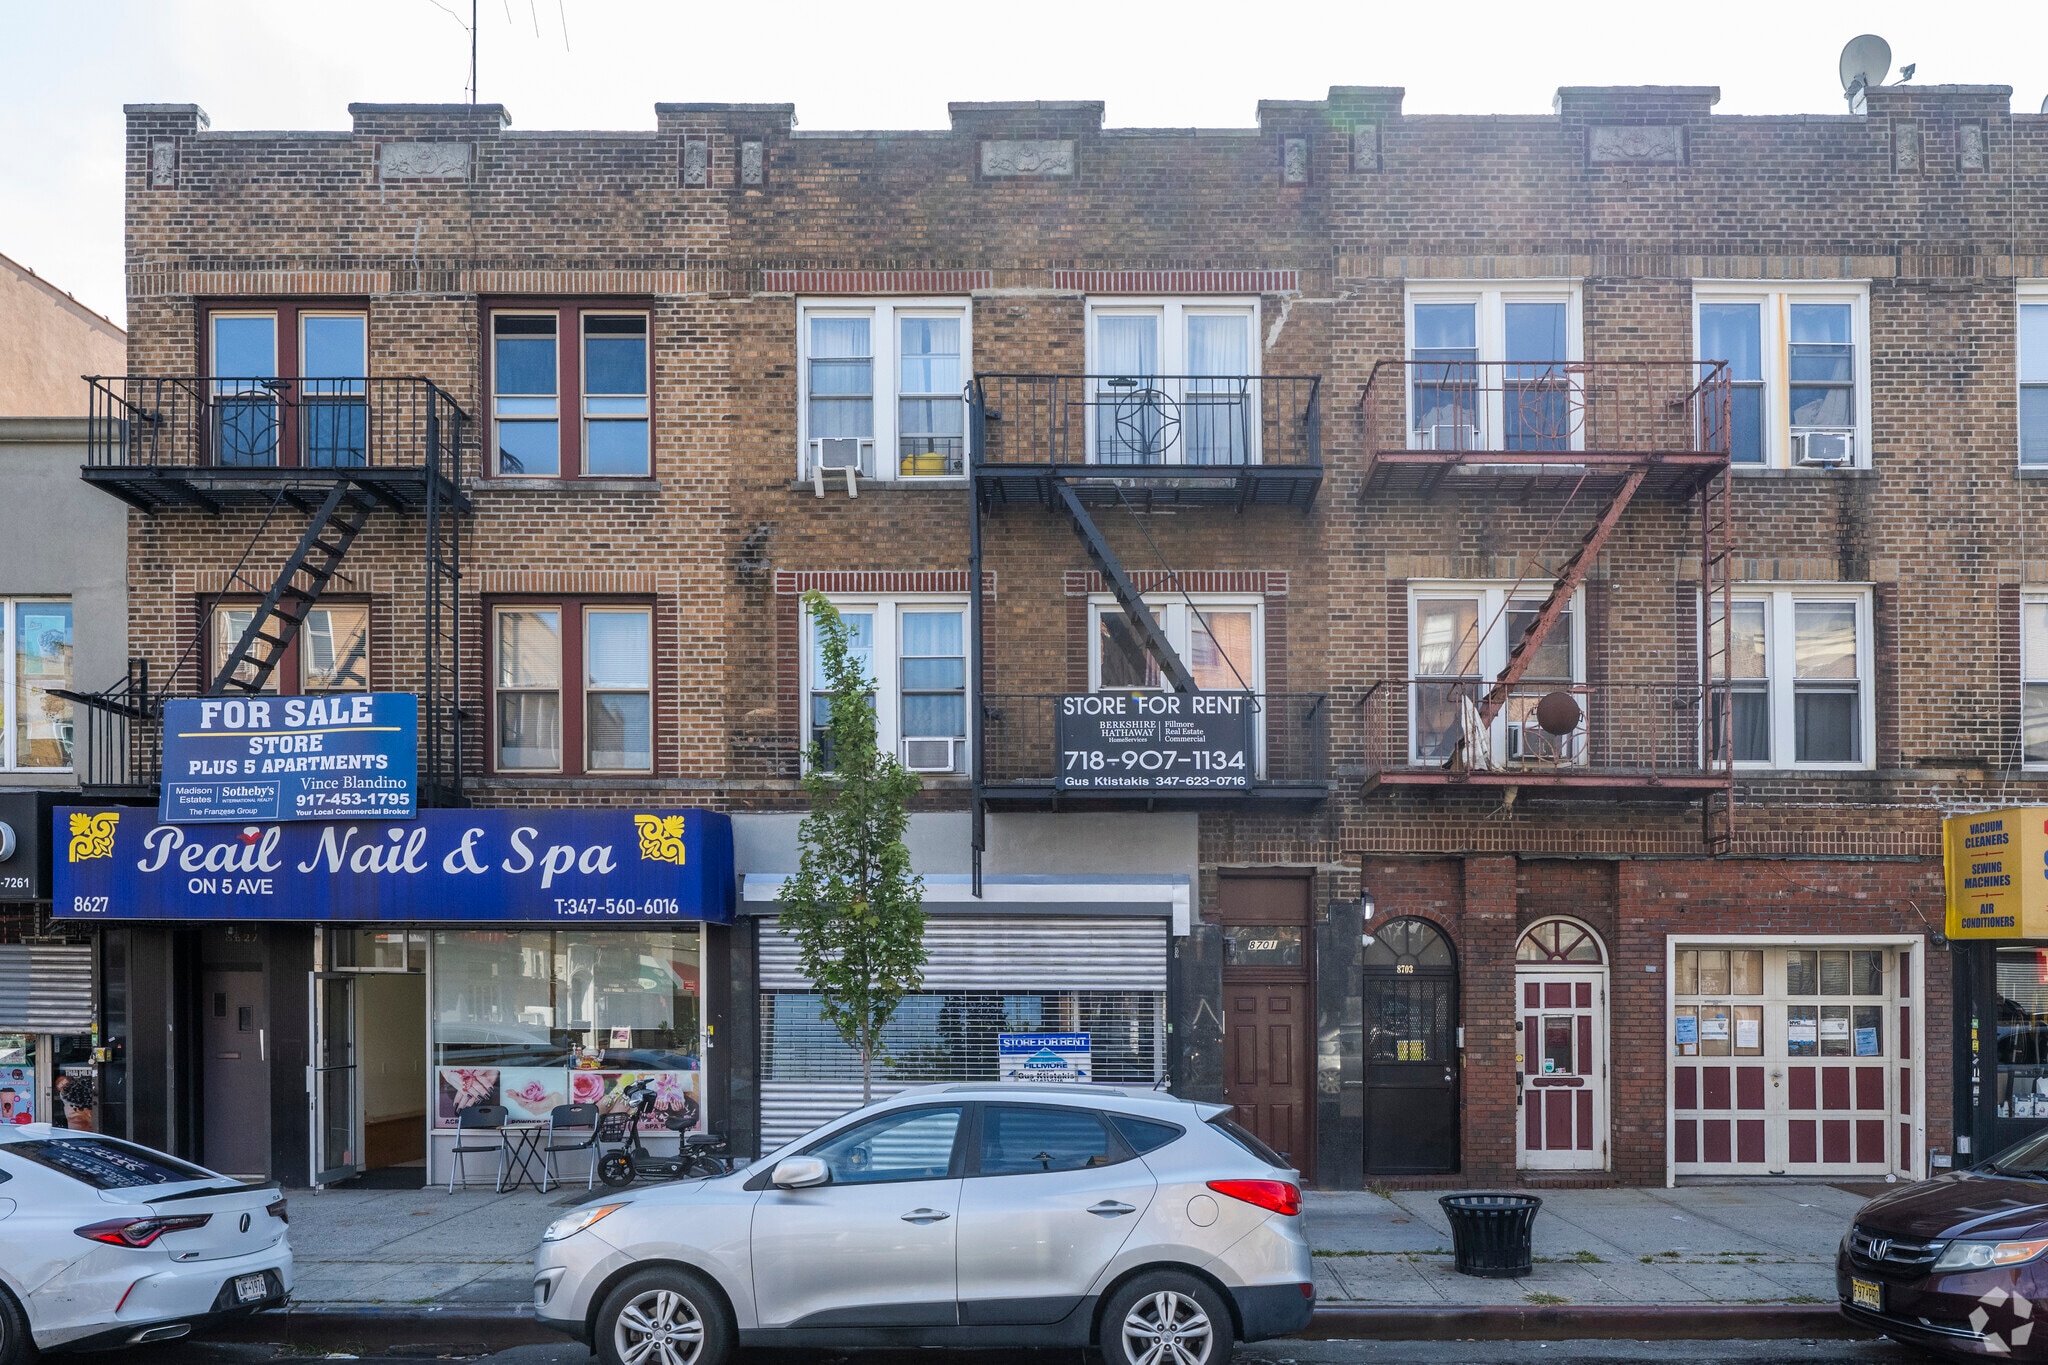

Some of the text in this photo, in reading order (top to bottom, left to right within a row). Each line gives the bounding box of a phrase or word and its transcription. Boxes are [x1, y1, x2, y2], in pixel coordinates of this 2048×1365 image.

[1063, 696, 1242, 715] STORE FOR RENT
[200, 696, 373, 729] FOR SALE
[1100, 720, 1156, 729] BERKSHIRE
[1164, 720, 1194, 728] Fillmore
[1101, 729, 1155, 737] HATHAWAY
[1164, 735, 1206, 743] Commercial
[249, 734, 323, 755] STORE
[188, 754, 388, 775] PLUS 5 APARTMENTS
[1064, 750, 1246, 770] 718-907-1134
[300, 775, 407, 790] Vince Blandino
[1064, 776, 1246, 786] Gus Ktistakis 347-623-0716
[175, 786, 213, 795] Madison
[222, 785, 275, 797] Sotheby's
[179, 795, 212, 804] Estates
[296, 793, 410, 806] 917-453-1795
[189, 807, 258, 816] The Franzese Group
[313, 808, 334, 816] Local
[1969, 820, 2003, 835] VACUUM
[1965, 833, 2009, 849] CLEANERS
[297, 826, 428, 873] Nail
[442, 827, 489, 874] &
[501, 826, 617, 889] Spa
[1971, 861, 2002, 875] SEWING
[188, 878, 273, 895] ON 5 AVE
[1964, 875, 2011, 889] MACHINES
[74, 896, 109, 912] 8627
[554, 899, 679, 914] T:347-560-6016
[1980, 903, 1994, 915] AIR
[1961, 916, 2015, 929] CONDITIONERS
[1249, 940, 1276, 950] 8701
[1396, 964, 1414, 974] 8703
[1003, 1037, 1086, 1047] STORE FOR RENT
